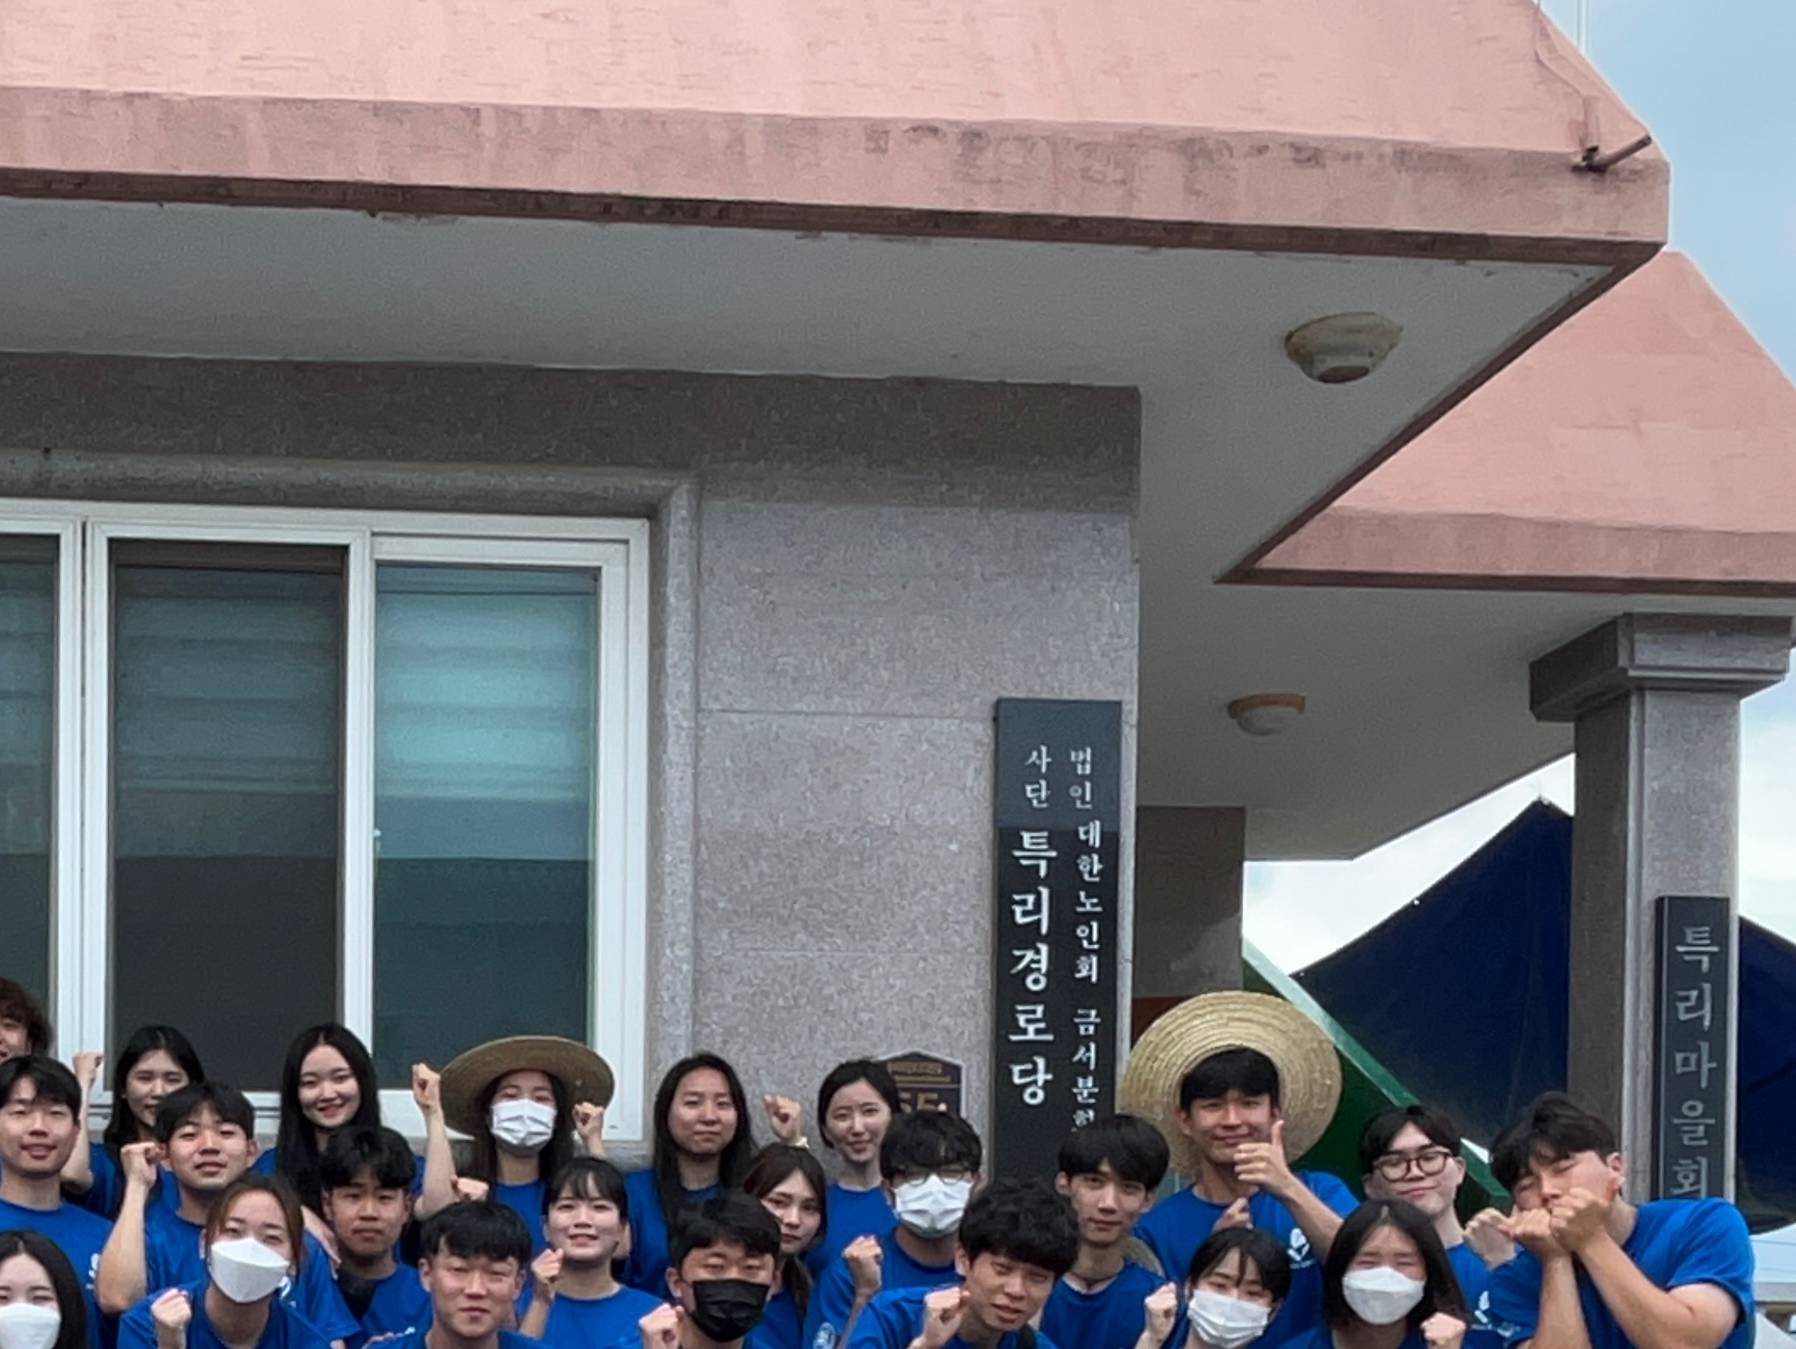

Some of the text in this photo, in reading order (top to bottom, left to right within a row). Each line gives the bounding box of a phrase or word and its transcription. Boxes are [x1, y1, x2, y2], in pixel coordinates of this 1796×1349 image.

[1024, 745, 1052, 808] 사단
[1069, 747, 1093, 809] 법인
[1008, 829, 1059, 1106] 특리경로당
[1074, 820, 1104, 984] 대한노인회
[1669, 925, 1720, 1199] 특리마을회
